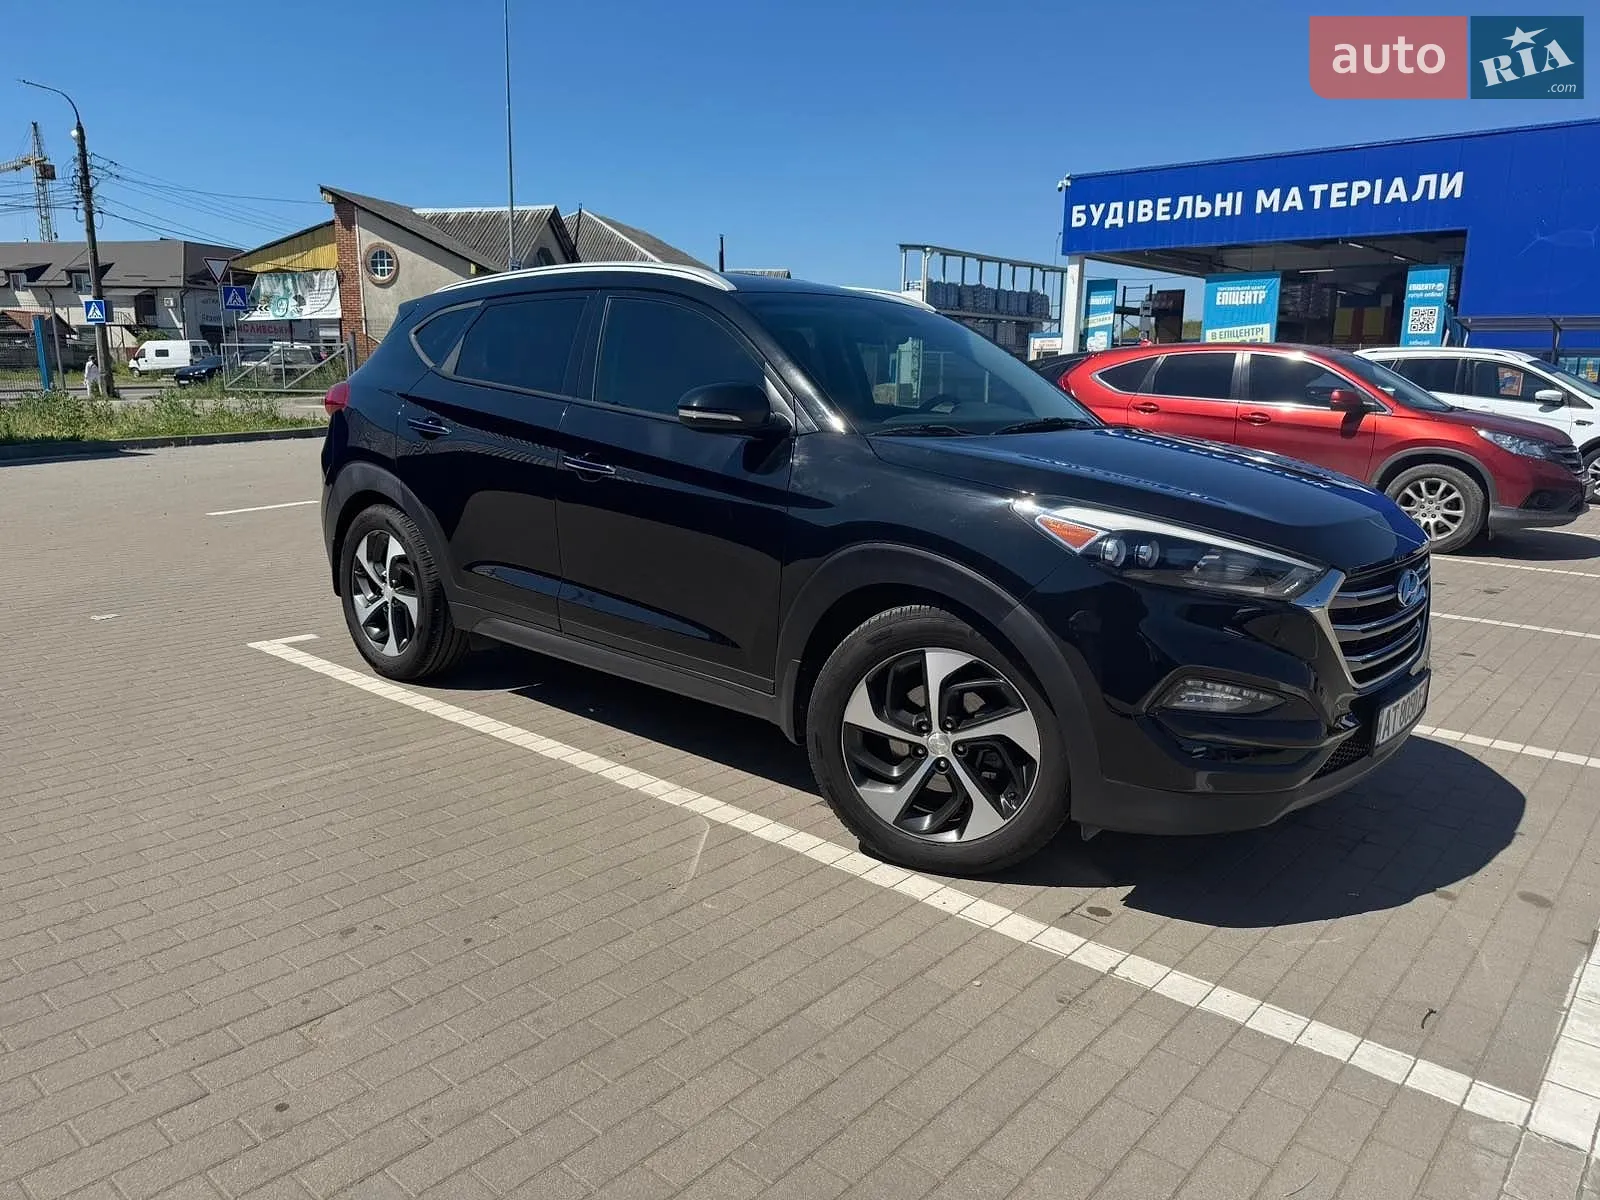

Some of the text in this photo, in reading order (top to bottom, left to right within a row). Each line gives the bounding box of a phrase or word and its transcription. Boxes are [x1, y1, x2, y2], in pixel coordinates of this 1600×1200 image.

[1070, 171, 1465, 229] БУДІВЕЛЬНІ МАТЕРІАЛИ
[1216, 290, 1266, 305] ЕПІЦЕНТР
[1211, 331, 1217, 340] В
